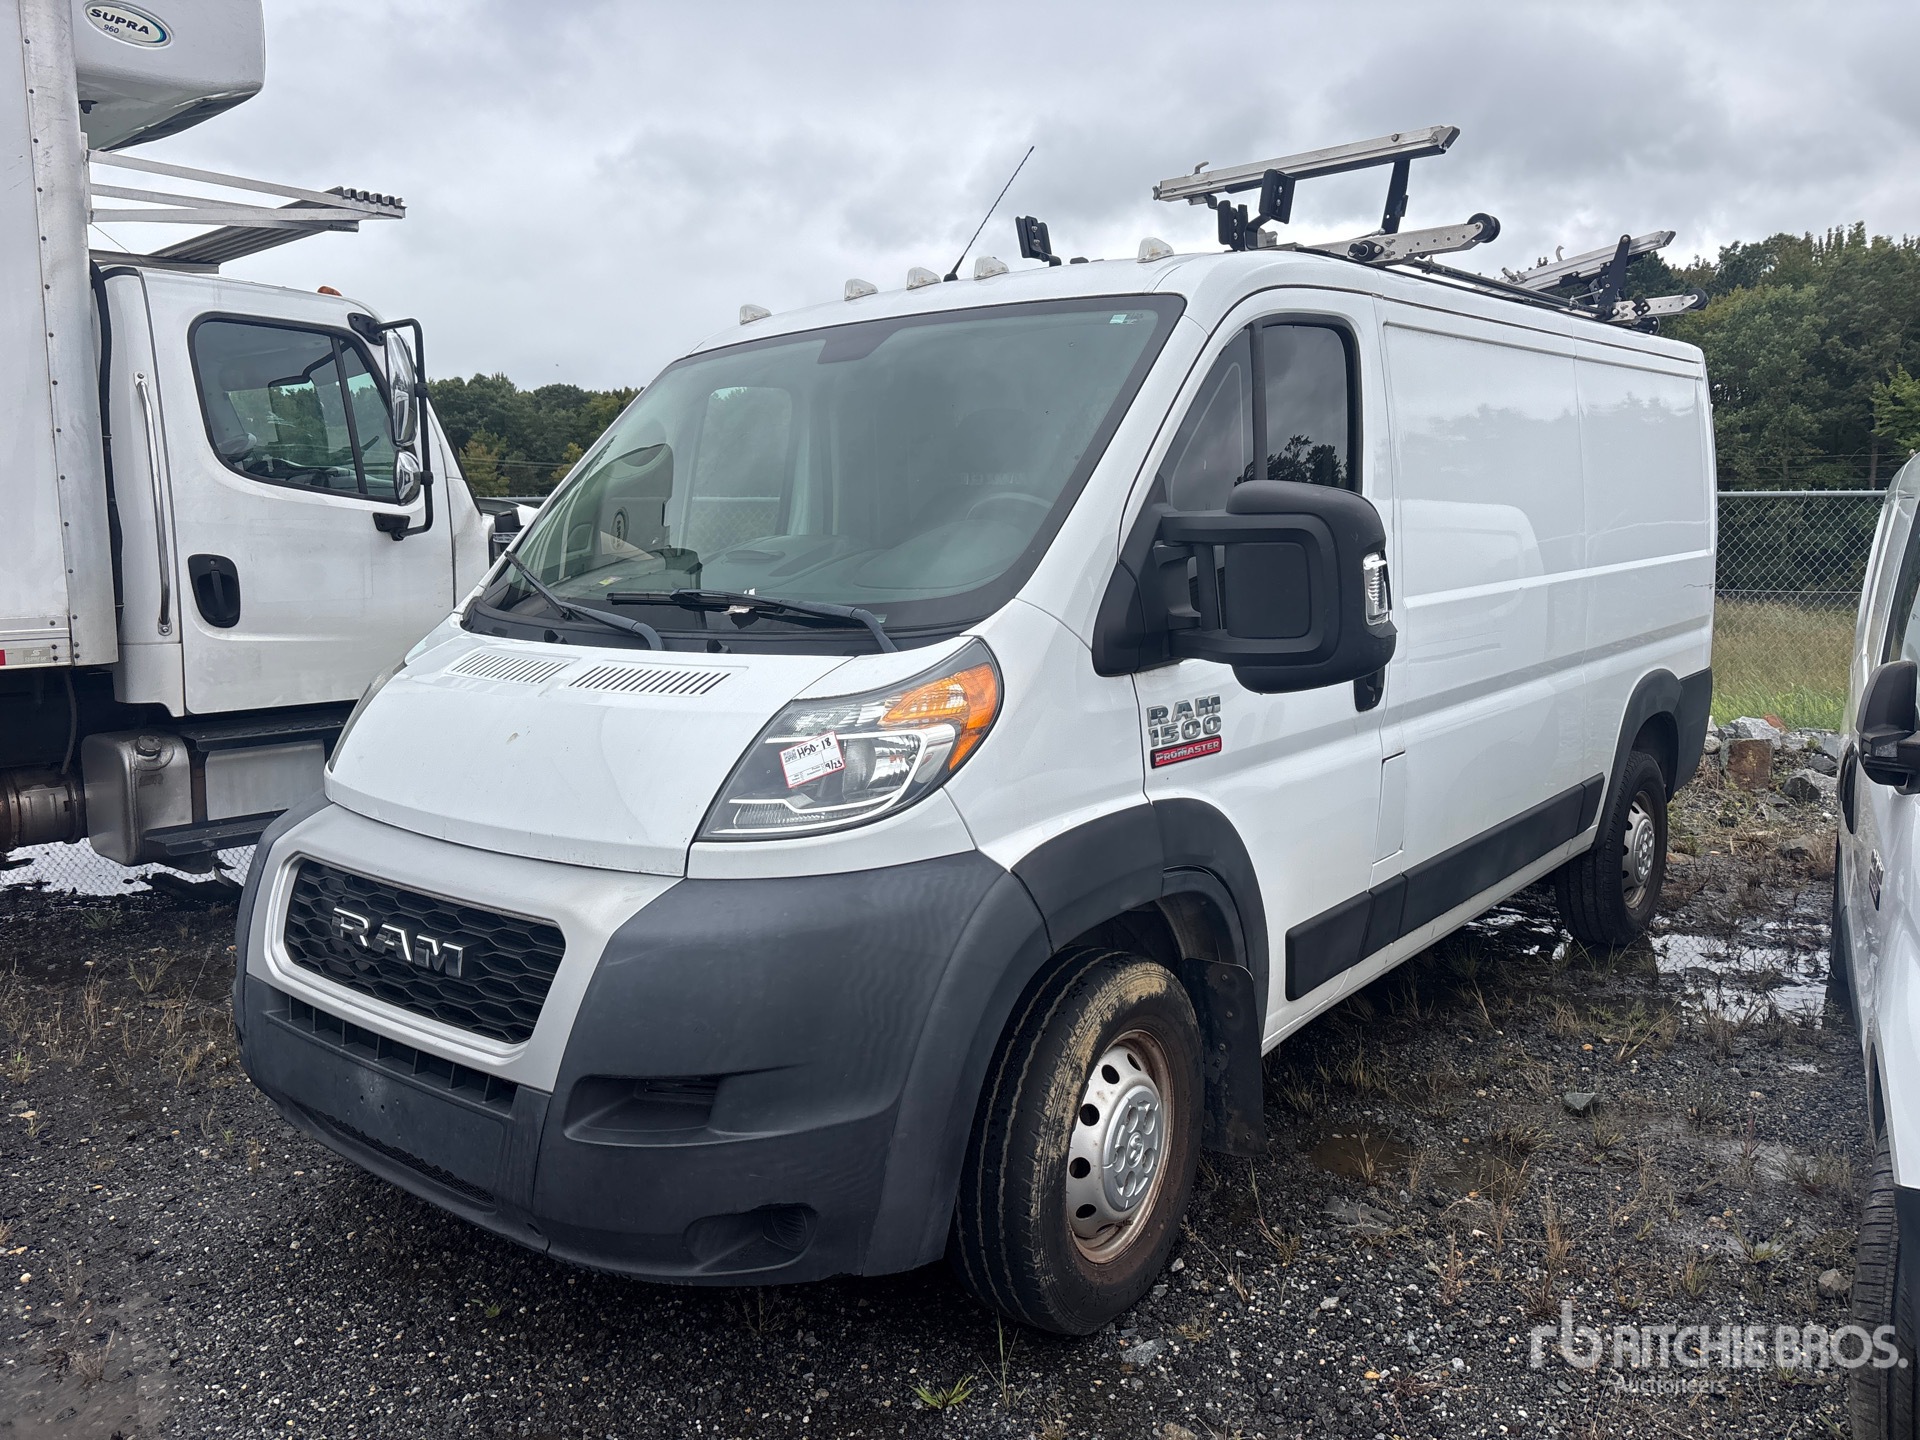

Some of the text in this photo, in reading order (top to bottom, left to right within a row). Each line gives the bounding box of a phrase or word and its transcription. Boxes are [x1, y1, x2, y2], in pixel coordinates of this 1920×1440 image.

[90, 8, 150, 35] SUPRA
[103, 24, 120, 34] 960
[1146, 694, 1221, 727] RAM
[1148, 714, 1222, 747] 1500
[1155, 740, 1220, 763] PROMASTER
[332, 907, 464, 978] RAM
